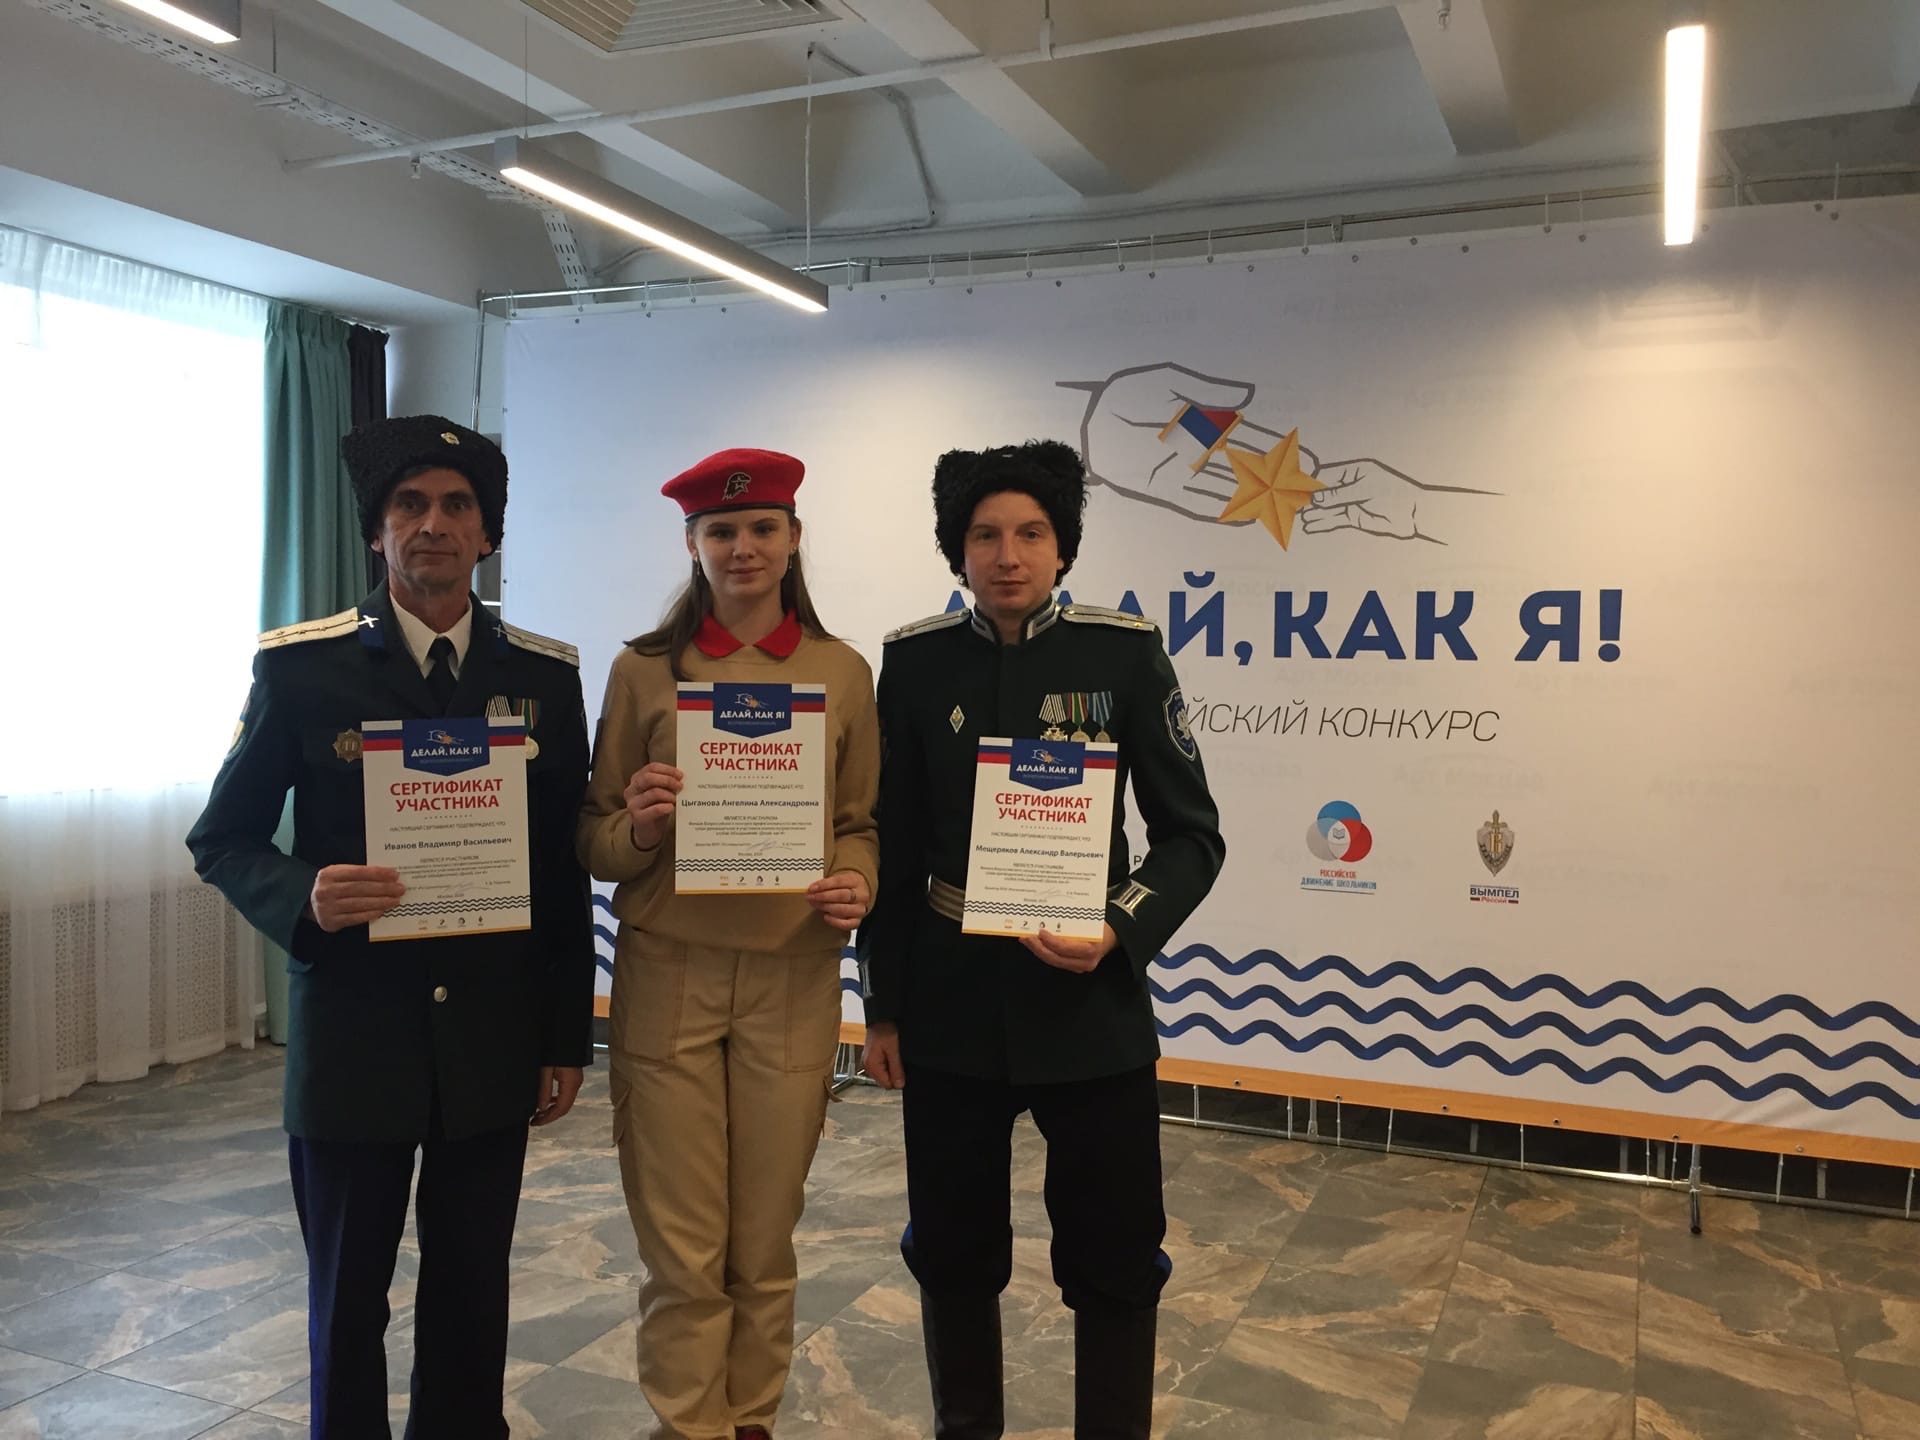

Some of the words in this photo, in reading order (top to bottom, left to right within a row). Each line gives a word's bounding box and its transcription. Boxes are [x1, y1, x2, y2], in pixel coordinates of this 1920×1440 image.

[1274, 590, 1478, 661] КАК
[1514, 589, 1623, 663] Я!
[720, 709, 753, 719] ДЕЛАЙ,
[755, 711, 773, 719] КАК
[1186, 697, 1308, 735] ЙСКИЙ
[1318, 707, 1500, 742] КОНКУРС
[449, 748, 470, 756] КАК
[699, 742, 803, 755] СЕРТИФИКАТ
[704, 758, 798, 771] УЧАСТНИКА
[390, 779, 503, 796] СЕРТИФИКАТ
[396, 795, 499, 812] УЧАСТНИКА
[681, 799, 720, 808] Цыганова
[722, 799, 758, 807] Ангелина
[760, 799, 819, 808] Александровна
[995, 793, 1093, 809] СЕРТИФИКАТ
[999, 808, 1087, 823] УЧАСТНИКА
[384, 842, 417, 851] Иванов
[418, 839, 461, 850] Владимир
[463, 837, 512, 847] Васильевич
[976, 845, 1018, 854] Мещеряков
[1020, 847, 1059, 857] Александр
[1060, 850, 1104, 859] Валерьевич
[1470, 887, 1519, 898] ВЫМПЕЛ
